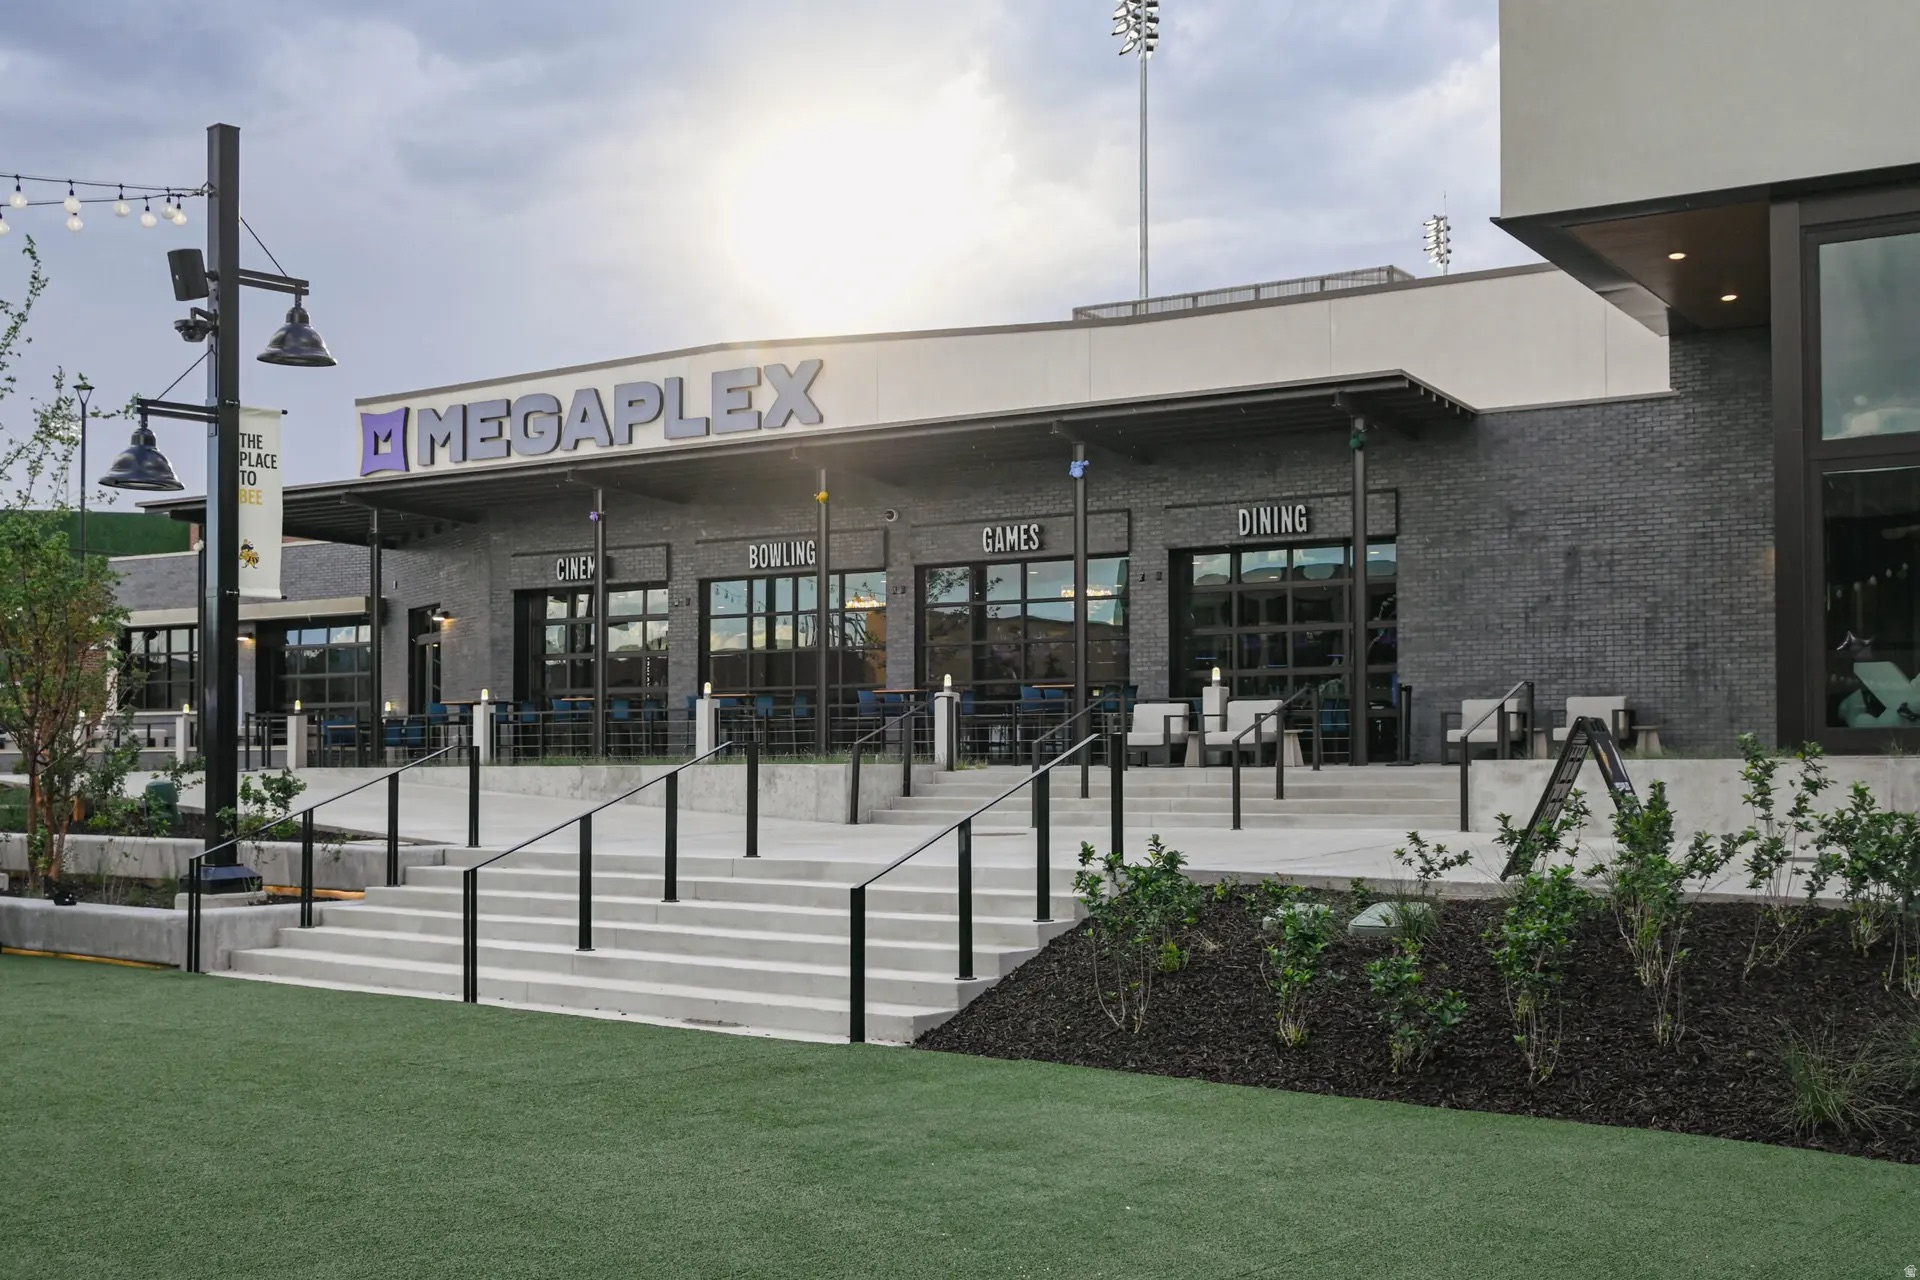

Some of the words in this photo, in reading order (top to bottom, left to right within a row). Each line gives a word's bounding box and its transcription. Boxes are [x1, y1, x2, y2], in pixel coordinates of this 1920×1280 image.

[416, 358, 824, 466] MEGAPLEX
[239, 432, 263, 450] THE
[239, 451, 278, 469] PLACE
[239, 470, 257, 486] TO
[239, 488, 263, 506] BEE
[1238, 504, 1307, 536] DINING
[982, 523, 1039, 553] GAMES
[749, 540, 816, 569] BOWLING
[556, 555, 596, 581] CINEM
